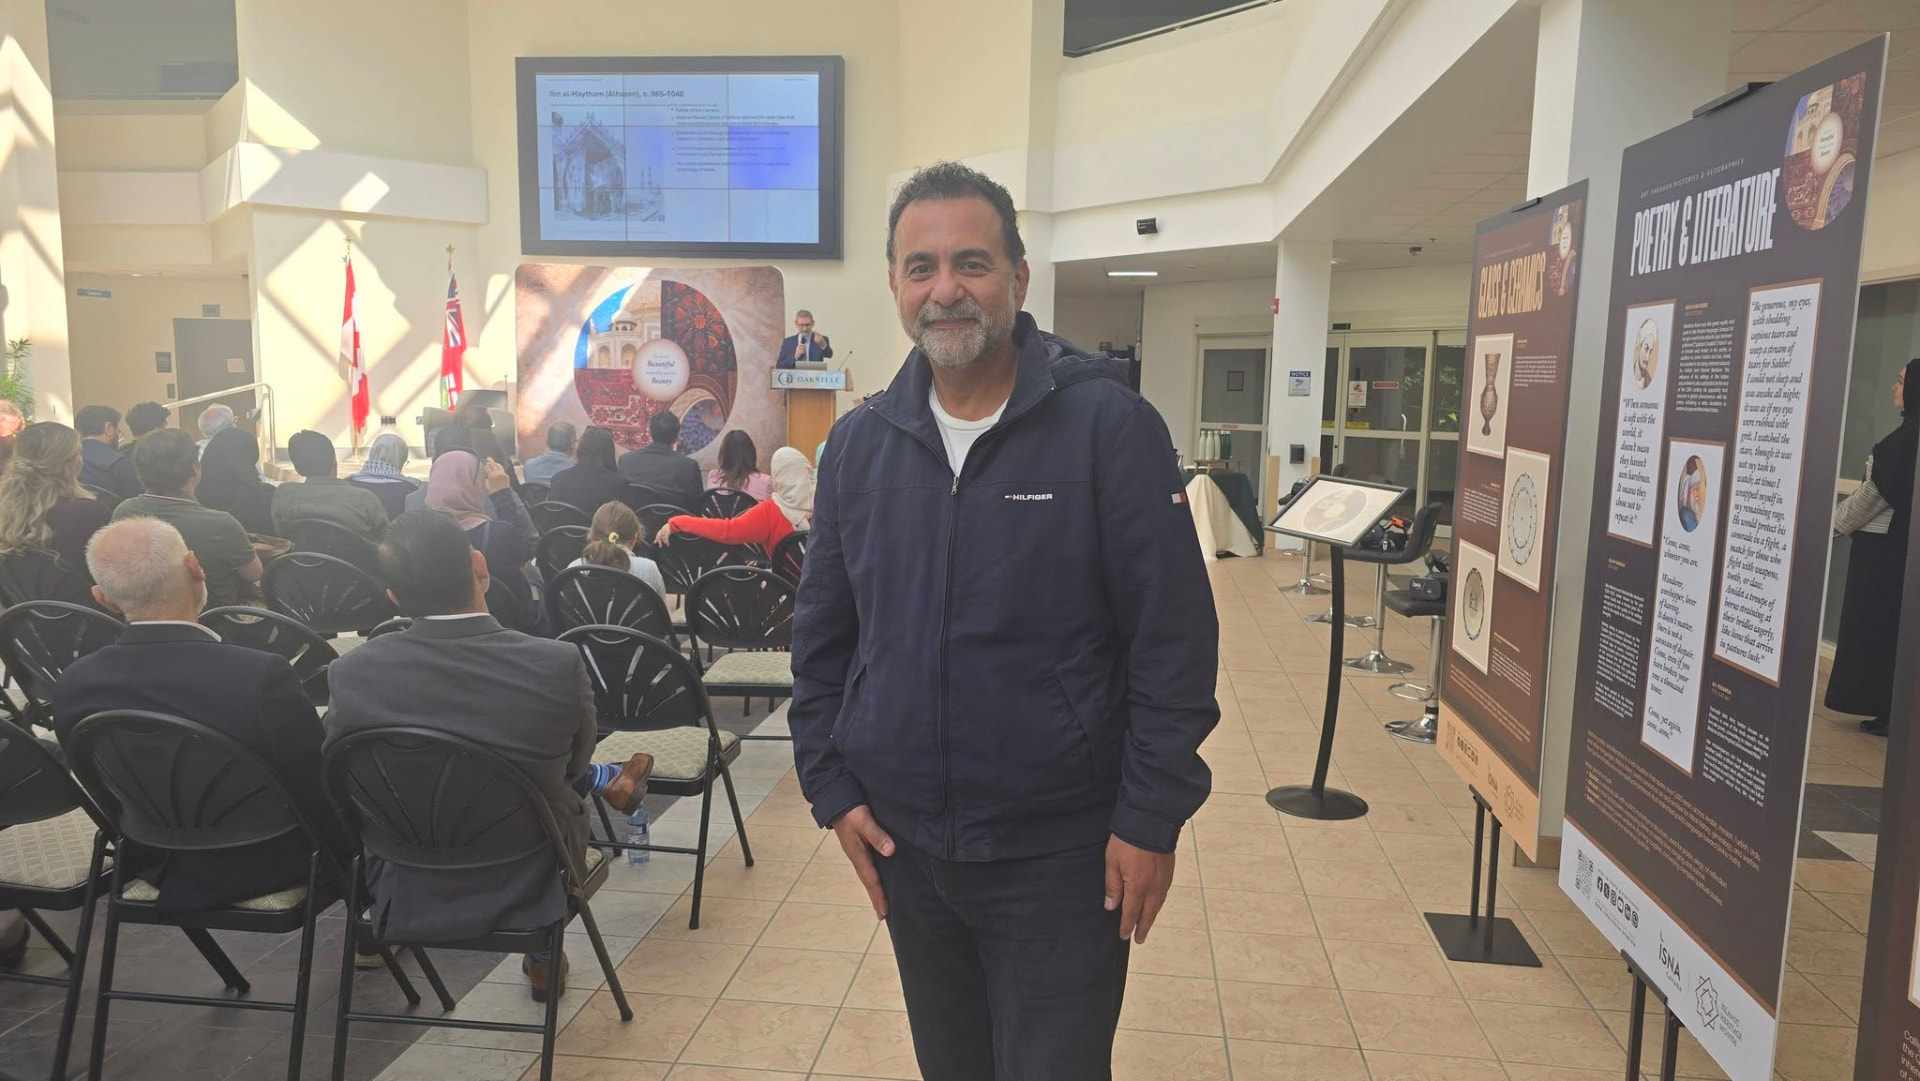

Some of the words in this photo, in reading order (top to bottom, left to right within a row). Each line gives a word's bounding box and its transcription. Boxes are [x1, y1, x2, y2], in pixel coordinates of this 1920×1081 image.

[1674, 174, 1699, 187] HISTORIES
[1706, 157, 1745, 177] GEOGRAPHIES
[1630, 199, 1680, 277] POETRY
[1678, 195, 1693, 266] &
[1691, 168, 1781, 264] LITERATURE
[1478, 263, 1501, 319] GLASS
[1500, 261, 1508, 316] &
[1507, 251, 1546, 314] CERAMICS
[1760, 301, 1786, 314] generous,
[1788, 300, 1797, 311] my
[1798, 298, 1811, 310] eyes,
[1752, 315, 1765, 326] with
[1766, 312, 1791, 326] shedding
[1751, 329, 1770, 343] copious
[1771, 329, 1785, 338] tears
[1786, 327, 1799, 337] and
[1750, 346, 1763, 357] weep
[1767, 345, 1786, 353] stream
[1788, 342, 1796, 356] of
[1748, 360, 1761, 369] tears
[1760, 358, 1770, 372] for
[1750, 373, 1765, 383] could
[1766, 375, 1774, 383] not
[1775, 373, 1789, 387] sleep
[1789, 373, 1803, 383] and
[1745, 390, 1755, 398] was
[1756, 388, 1773, 398] awake
[1774, 388, 1783, 398] all
[1640, 401, 1659, 409] someone
[1744, 404, 1749, 412] it
[1767, 403, 1773, 416] if
[1773, 406, 1781, 416] my
[1782, 406, 1794, 417] eyes
[1628, 414, 1636, 426] soft
[1637, 413, 1647, 424] with
[1648, 414, 1656, 424] the
[1755, 417, 1775, 428] rubbed
[1776, 418, 1789, 429] with
[1638, 430, 1643, 438] it
[1754, 432, 1758, 441] I
[1758, 433, 1780, 443] watched
[1781, 433, 1790, 444] the
[1637, 445, 1649, 454] mean
[1755, 446, 1774, 460] though
[1775, 449, 1780, 458] it
[1619, 455, 1629, 468] they
[1748, 462, 1756, 473] my
[1757, 462, 1769, 472] task
[1770, 465, 1776, 473] to
[1619, 471, 1627, 479] seen
[1754, 478, 1761, 486] at
[1761, 477, 1776, 488] times
[1013, 493, 1053, 501] HILFIGER
[1617, 482, 1622, 492] It
[1622, 486, 1636, 495] means
[1637, 486, 1646, 501] they
[1736, 489, 1759, 502] wrapped
[1759, 492, 1777, 506] myself
[1777, 494, 1783, 504] in
[1636, 502, 1641, 511] to
[1734, 503, 1743, 514] my
[1743, 504, 1772, 520] remaining
[1615, 513, 1628, 524] repeat
[1732, 515, 1741, 524] He
[1741, 518, 1757, 528] would
[1756, 520, 1776, 535] protect
[1778, 524, 1786, 536] his
[1731, 530, 1753, 542] comrade
[1754, 534, 1760, 545] in
[1782, 543, 1787, 551] a
[1680, 555, 1690, 565] you
[1730, 544, 1746, 555] match
[1745, 547, 1755, 560] for
[1755, 549, 1769, 562] those
[1770, 554, 1782, 565] who
[1727, 555, 1742, 570] fight
[1742, 560, 1754, 572] with
[1742, 577, 1750, 585] or
[1685, 595, 1697, 607] lover
[1725, 584, 1745, 598] Amidst
[1749, 594, 1768, 609] troupe
[1768, 598, 1776, 612] of
[1724, 597, 1739, 611] horses
[1739, 604, 1764, 623] straining
[1764, 614, 1772, 623] at
[1722, 612, 1735, 623] their
[1735, 615, 1753, 630] bridles
[1655, 636, 1672, 648] caravan
[1672, 643, 1678, 654] of
[1720, 624, 1730, 636] like
[1730, 628, 1743, 641] lions
[1744, 634, 1755, 646] that
[1756, 640, 1774, 654] arrive
[1719, 638, 1726, 648] in
[1725, 641, 1747, 658] pastures
[1653, 658, 1663, 670] have
[1663, 663, 1678, 677] broken
[1677, 673, 1689, 682] your
[1667, 656, 1677, 664] even
[1676, 657, 1683, 669] if
[1680, 663, 1690, 671] you
[1663, 677, 1685, 694] thousand
[1660, 716, 1669, 725] yet
[1659, 943, 1681, 981] ISNA
[1665, 971, 1682, 992] CANADA
[1721, 1003, 1740, 1025] ISLAMIC
[1719, 1015, 1743, 1042] HERITAGE
[1719, 1025, 1737, 1047] MONTH
[1902, 1042, 1915, 1058] the
[1900, 1070, 1907, 1079] of
